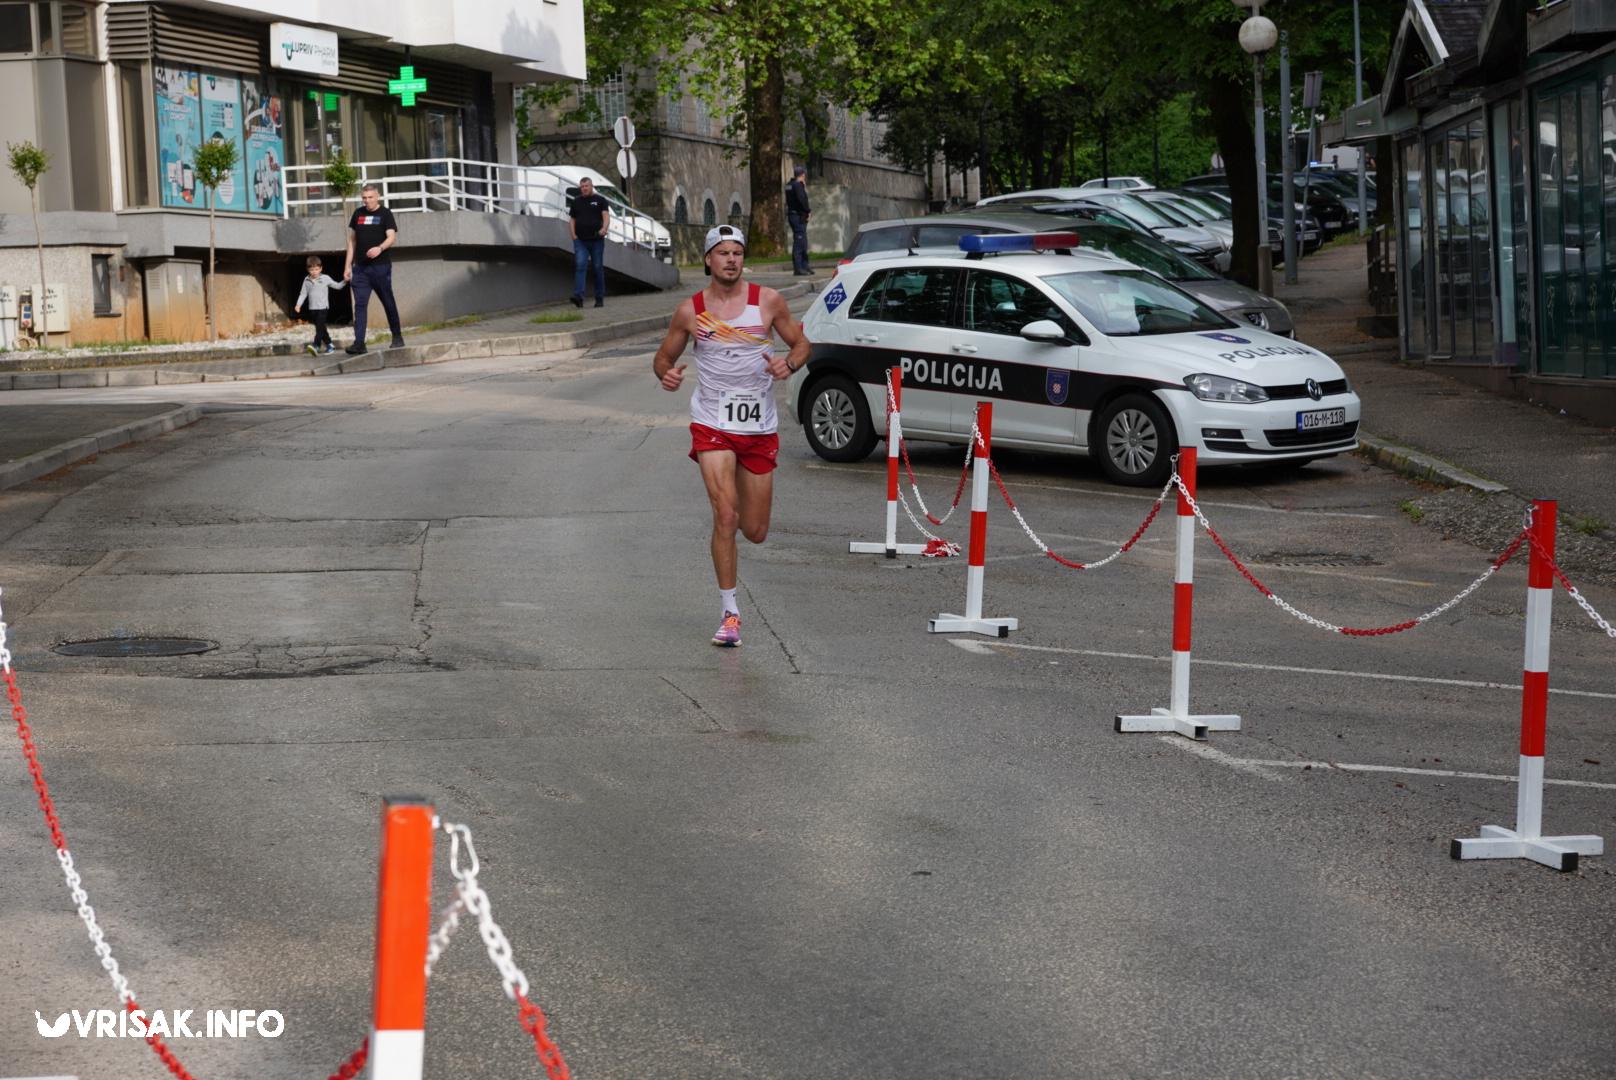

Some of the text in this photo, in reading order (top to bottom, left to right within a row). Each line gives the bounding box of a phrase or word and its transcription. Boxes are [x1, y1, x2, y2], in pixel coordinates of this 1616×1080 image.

[826, 294, 842, 305] 122
[1218, 346, 1318, 363] POLICIJA
[900, 357, 1003, 391] POLICIJA
[724, 402, 761, 422] 104
[1304, 411, 1344, 427] 016-M-118
